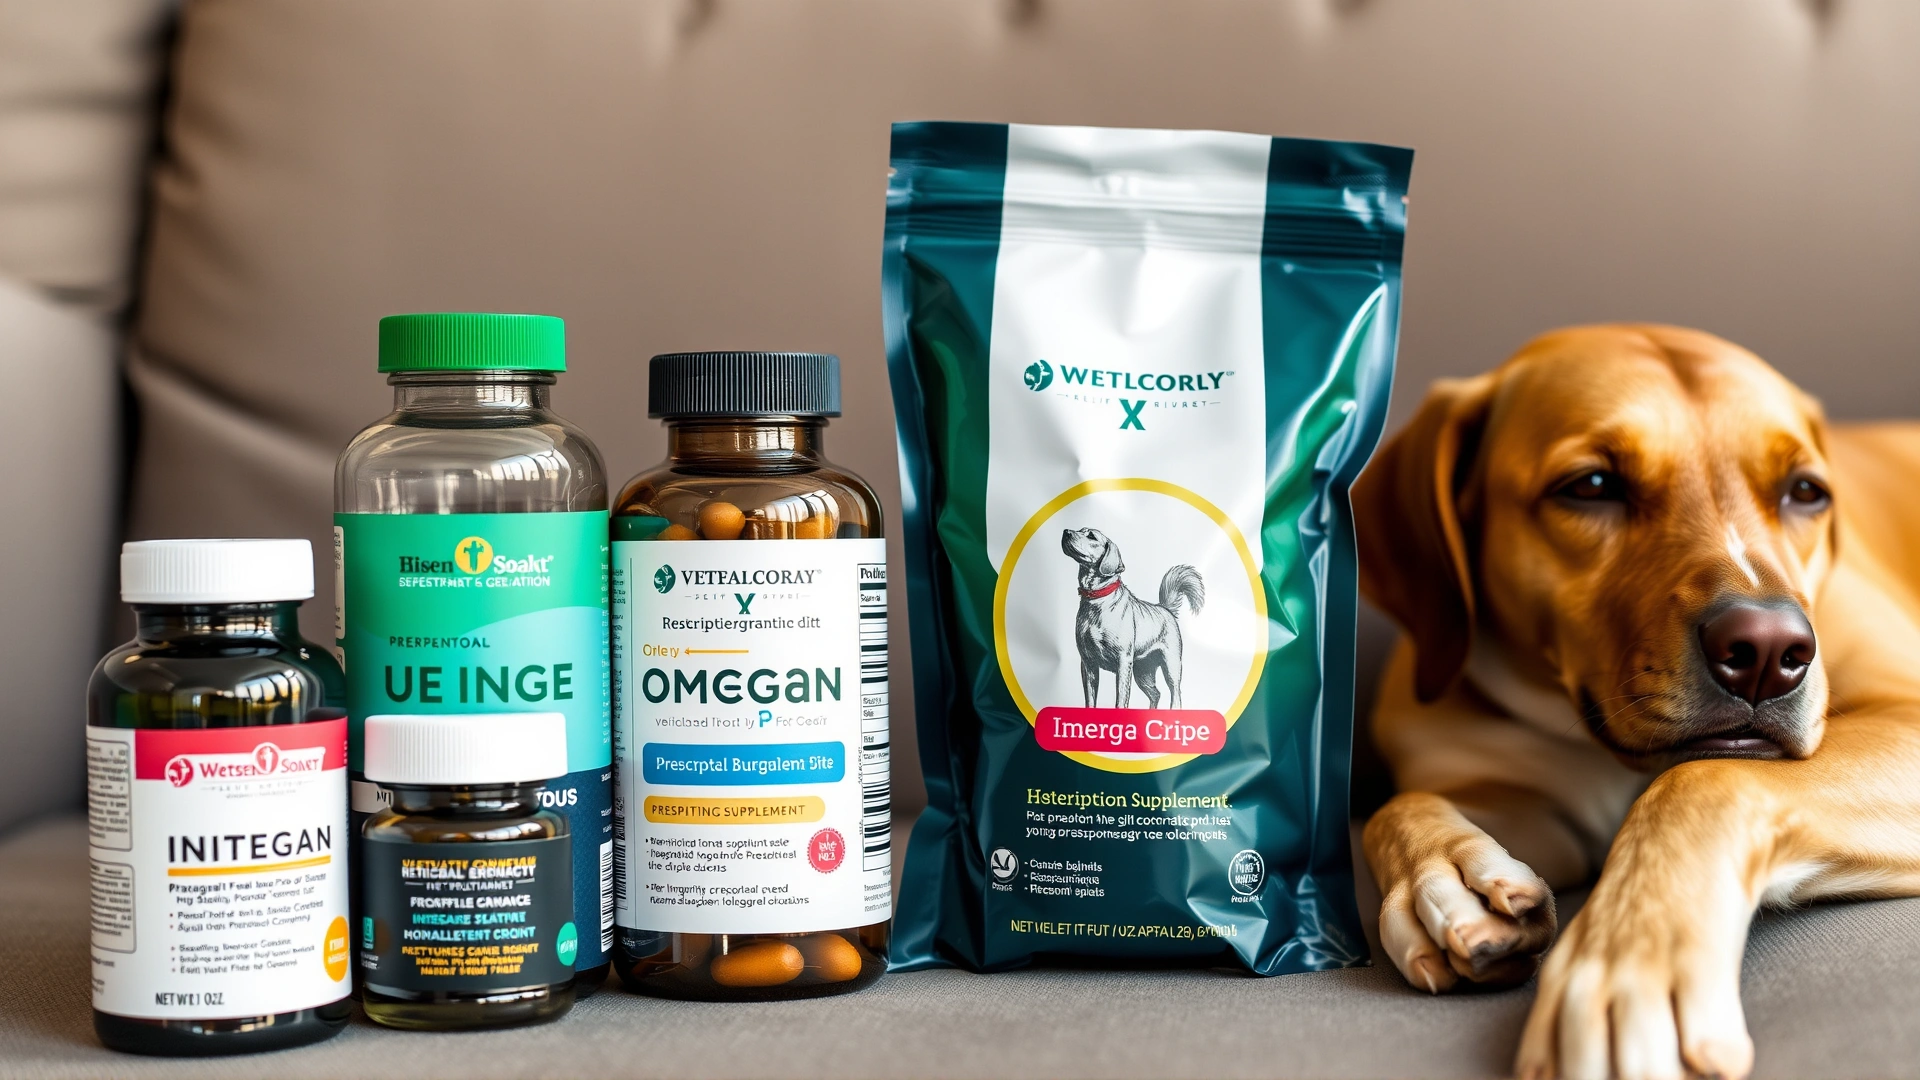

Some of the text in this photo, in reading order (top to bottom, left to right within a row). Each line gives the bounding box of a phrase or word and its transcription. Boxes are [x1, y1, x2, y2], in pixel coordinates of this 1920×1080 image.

[1118, 398, 1147, 431] X
[385, 662, 573, 703] UE INGE
[1053, 717, 1210, 745] Imerga Cripe
[724, 804, 806, 817] SUPPLEMENT
[169, 825, 331, 863] INITEGAN
[1011, 919, 1033, 933] NET
